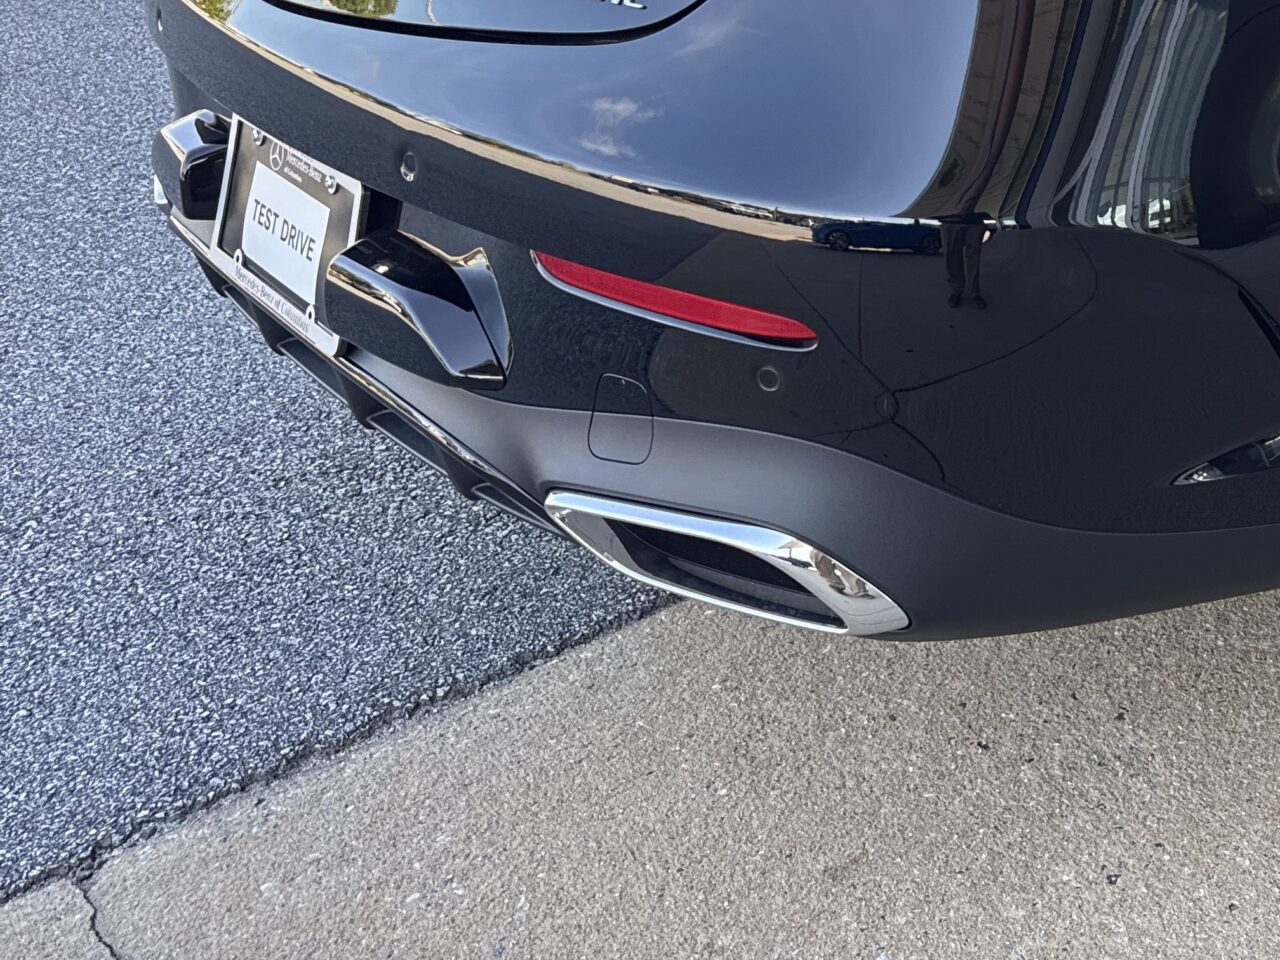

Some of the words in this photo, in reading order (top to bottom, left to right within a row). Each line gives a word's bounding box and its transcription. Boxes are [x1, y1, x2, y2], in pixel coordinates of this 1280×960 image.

[252, 198, 280, 236] TEST
[280, 217, 316, 262] DRIVE
[235, 265, 275, 305] Mercedes-Benz
